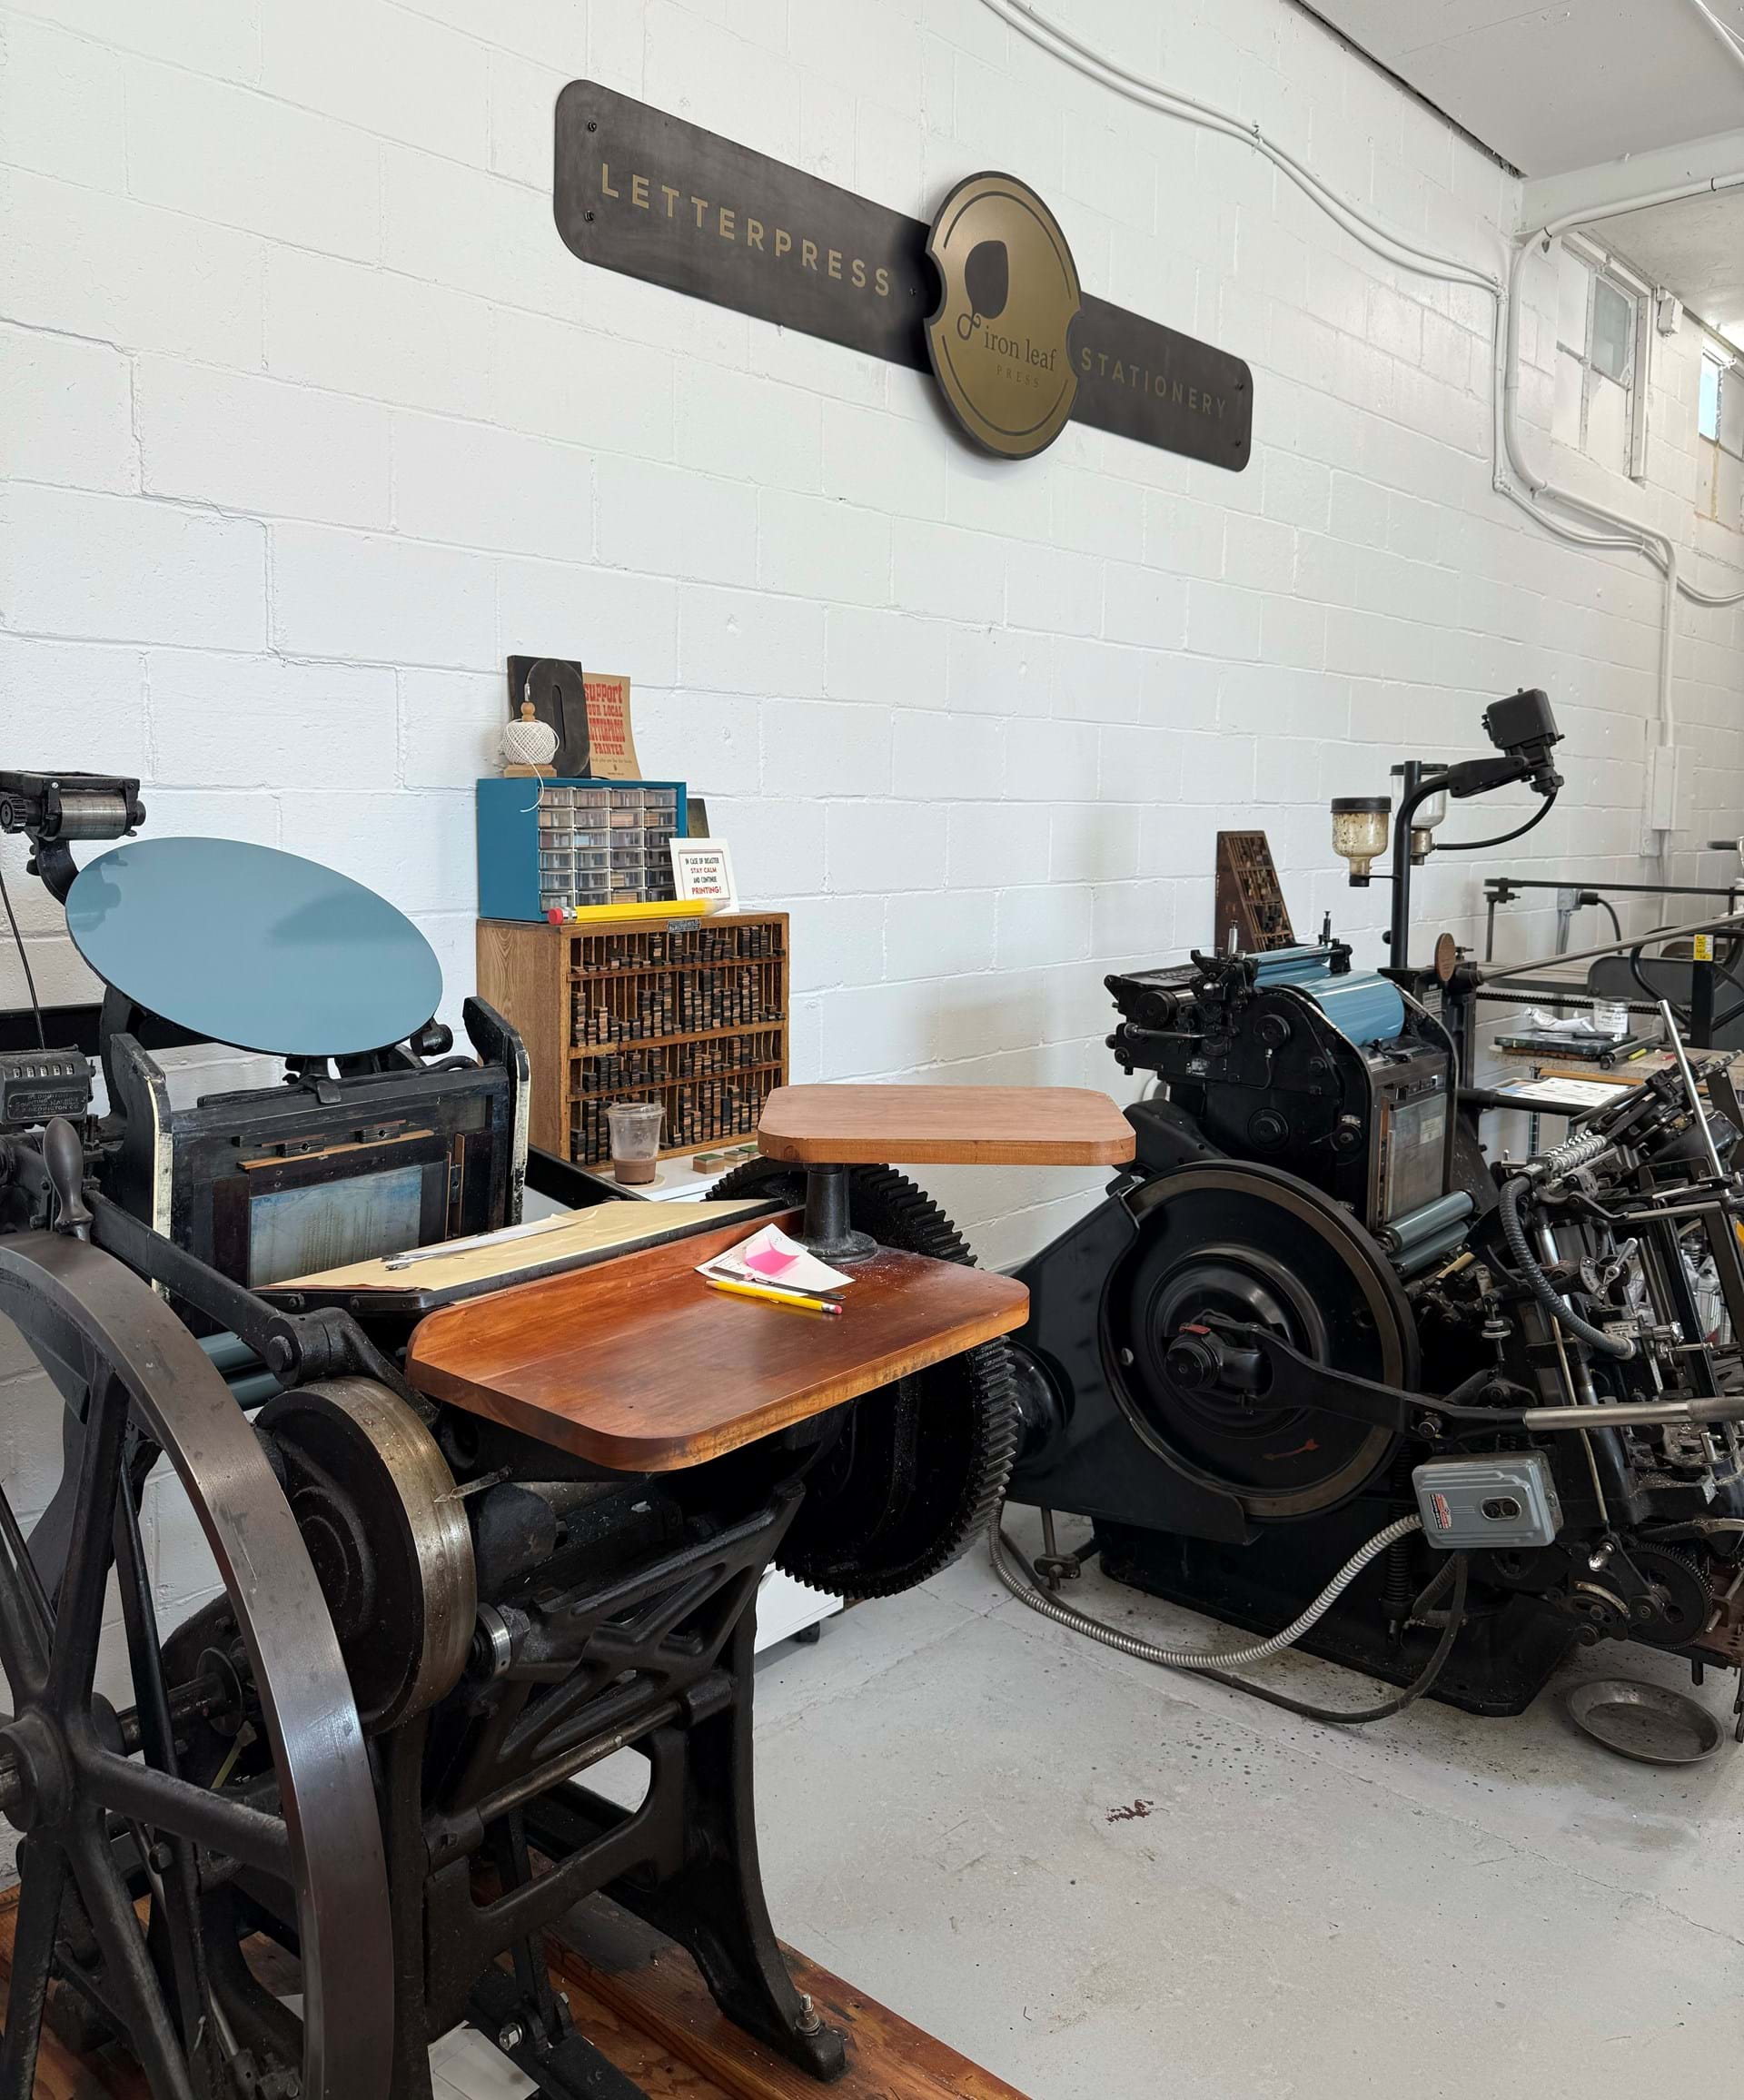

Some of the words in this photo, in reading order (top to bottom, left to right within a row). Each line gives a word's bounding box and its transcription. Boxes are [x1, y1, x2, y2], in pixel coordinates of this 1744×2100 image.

[601, 163, 889, 296] LETTERPRESS
[985, 325, 1019, 360] iron
[1025, 339, 1056, 371] leaf
[996, 364, 1039, 388] PRESS
[1082, 347, 1226, 420] STATIONERY
[603, 705, 623, 718] LOCAL
[594, 743, 625, 756] PRINTER
[691, 887, 722, 895] PRINTING!
